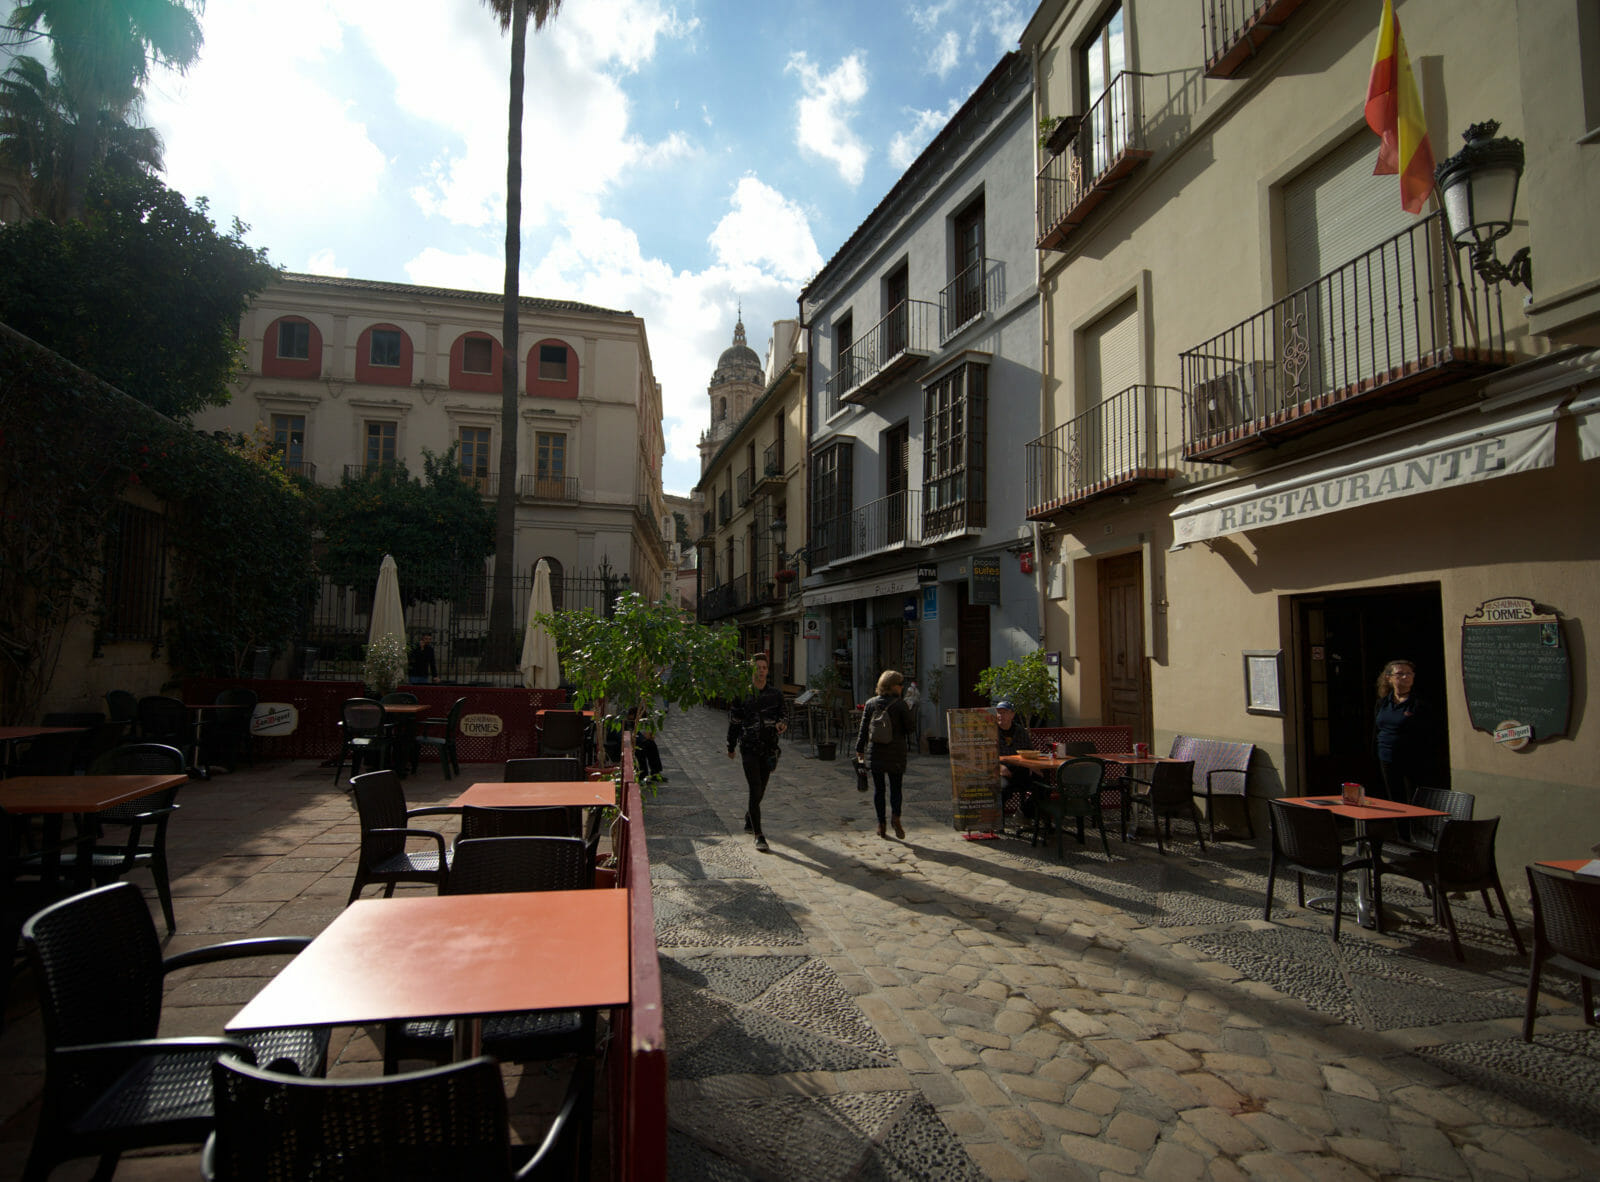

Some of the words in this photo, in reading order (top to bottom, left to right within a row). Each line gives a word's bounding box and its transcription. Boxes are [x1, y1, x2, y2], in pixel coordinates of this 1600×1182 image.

[1219, 440, 1507, 531] RESTAURANTE
[918, 568, 936, 577] ATM
[1486, 600, 1531, 609] RESTAURANTE
[1485, 608, 1532, 621] TORMES
[464, 722, 499, 733] TORMES
